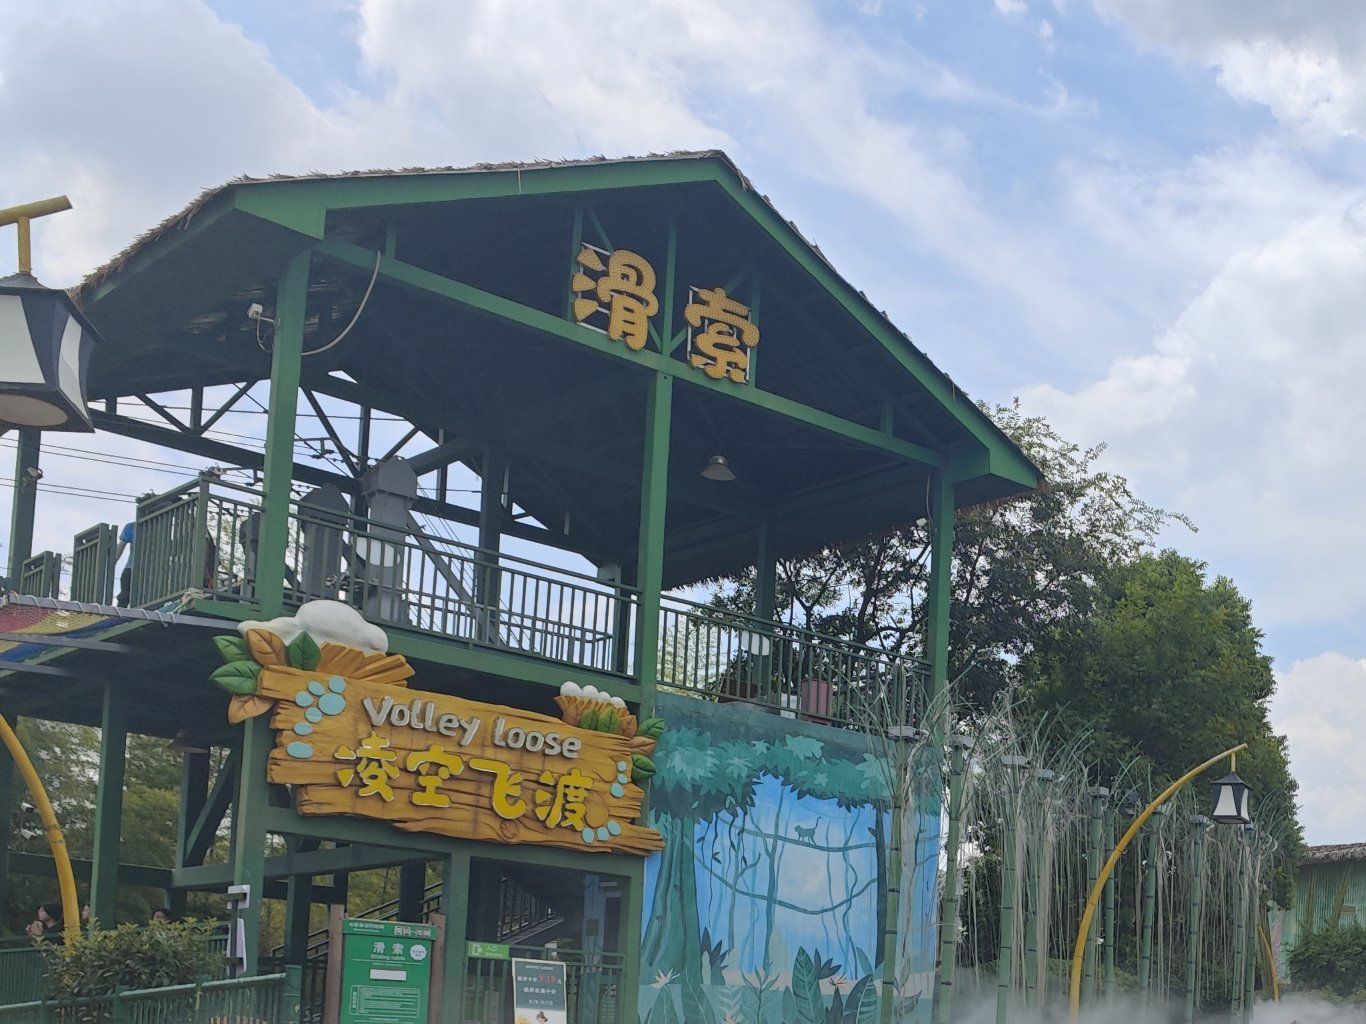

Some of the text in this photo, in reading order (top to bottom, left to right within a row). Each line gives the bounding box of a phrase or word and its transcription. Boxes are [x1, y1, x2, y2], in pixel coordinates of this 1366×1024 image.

[573, 249, 760, 383] 滑索
[363, 696, 480, 747] Volley
[334, 731, 595, 832] 凌空飞渡
